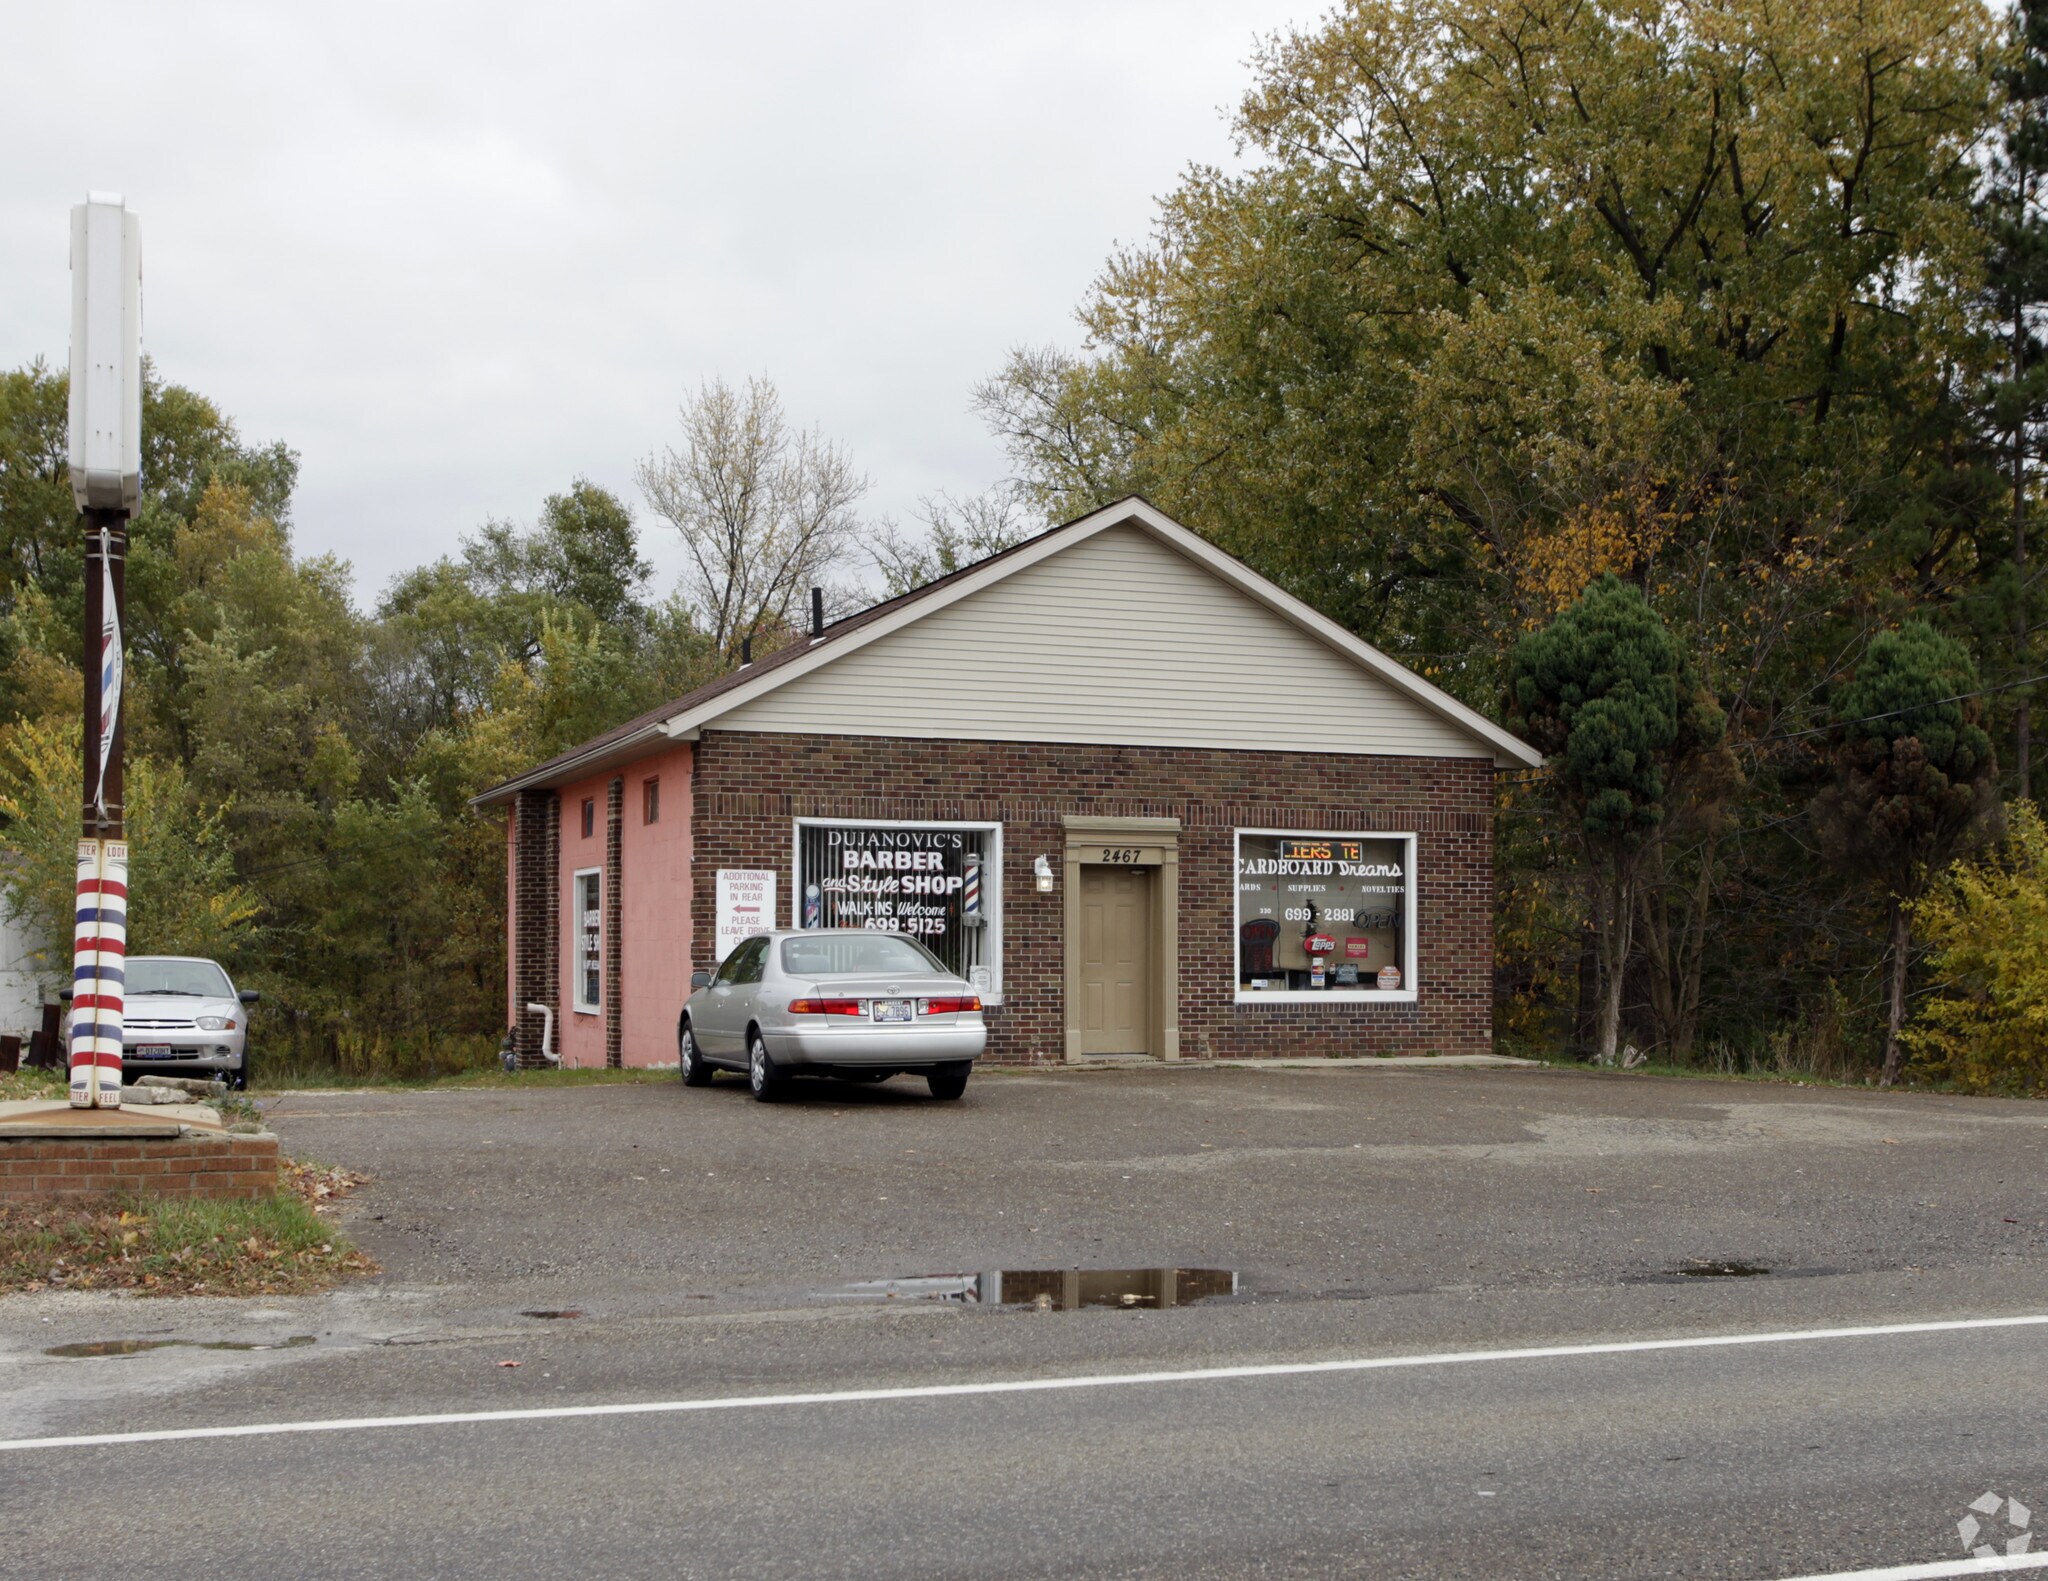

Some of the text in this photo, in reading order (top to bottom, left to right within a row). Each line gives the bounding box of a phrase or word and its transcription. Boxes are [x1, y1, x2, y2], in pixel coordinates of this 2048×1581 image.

[827, 831, 963, 848] DUJANOVIC'S
[107, 847, 125, 858] LOOK
[1102, 848, 1141, 863] 2467
[843, 850, 944, 870] BARBER
[1239, 858, 1403, 877] CARDBOARD Dreams
[723, 872, 770, 881] ADDITIONAL
[729, 882, 763, 891] PARKING
[822, 874, 964, 899] and Style SHOP
[1239, 883, 1405, 893] ARDS SUPPLIES NOVELTIES
[730, 893, 763, 902] IN REAR
[837, 900, 946, 917] WALK-INS Welcome
[1259, 907, 1272, 915] 330
[1285, 908, 1311, 922] 699
[1324, 908, 1355, 922] 2881
[1356, 910, 1402, 929] OPEN
[731, 916, 760, 925] PLEASE
[721, 926, 744, 936] LEAVE
[891, 1006, 909, 1017] 7896
[99, 1093, 117, 1103] FEEL
